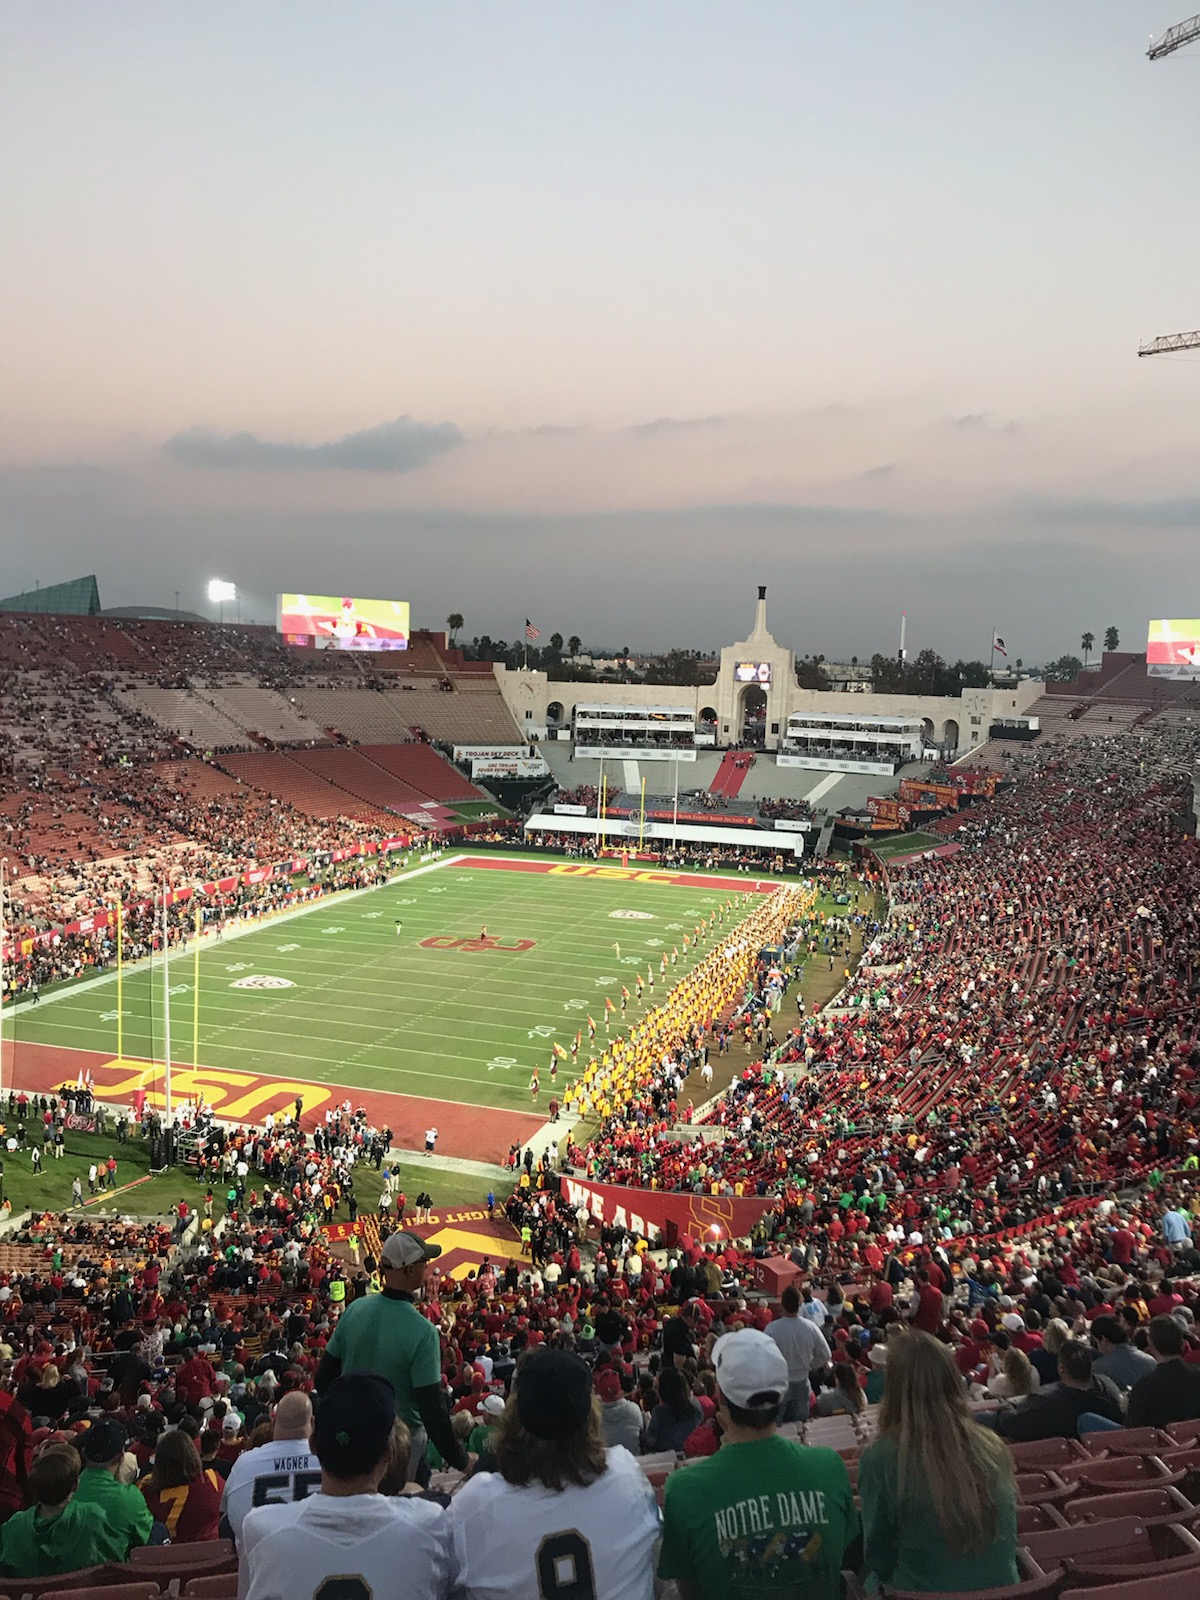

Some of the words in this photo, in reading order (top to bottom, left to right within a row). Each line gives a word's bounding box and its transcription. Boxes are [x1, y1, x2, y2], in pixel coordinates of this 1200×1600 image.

[547, 864, 681, 884] USC
[50, 1059, 333, 1122] USC
[566, 1178, 605, 1221] WE
[756, 1266, 765, 1284] 12
[305, 1299, 313, 1311] 3
[273, 1456, 309, 1472] WAGNER
[159, 1484, 190, 1538] 7
[714, 1494, 775, 1545] NOTRE
[776, 1490, 830, 1527] DAME
